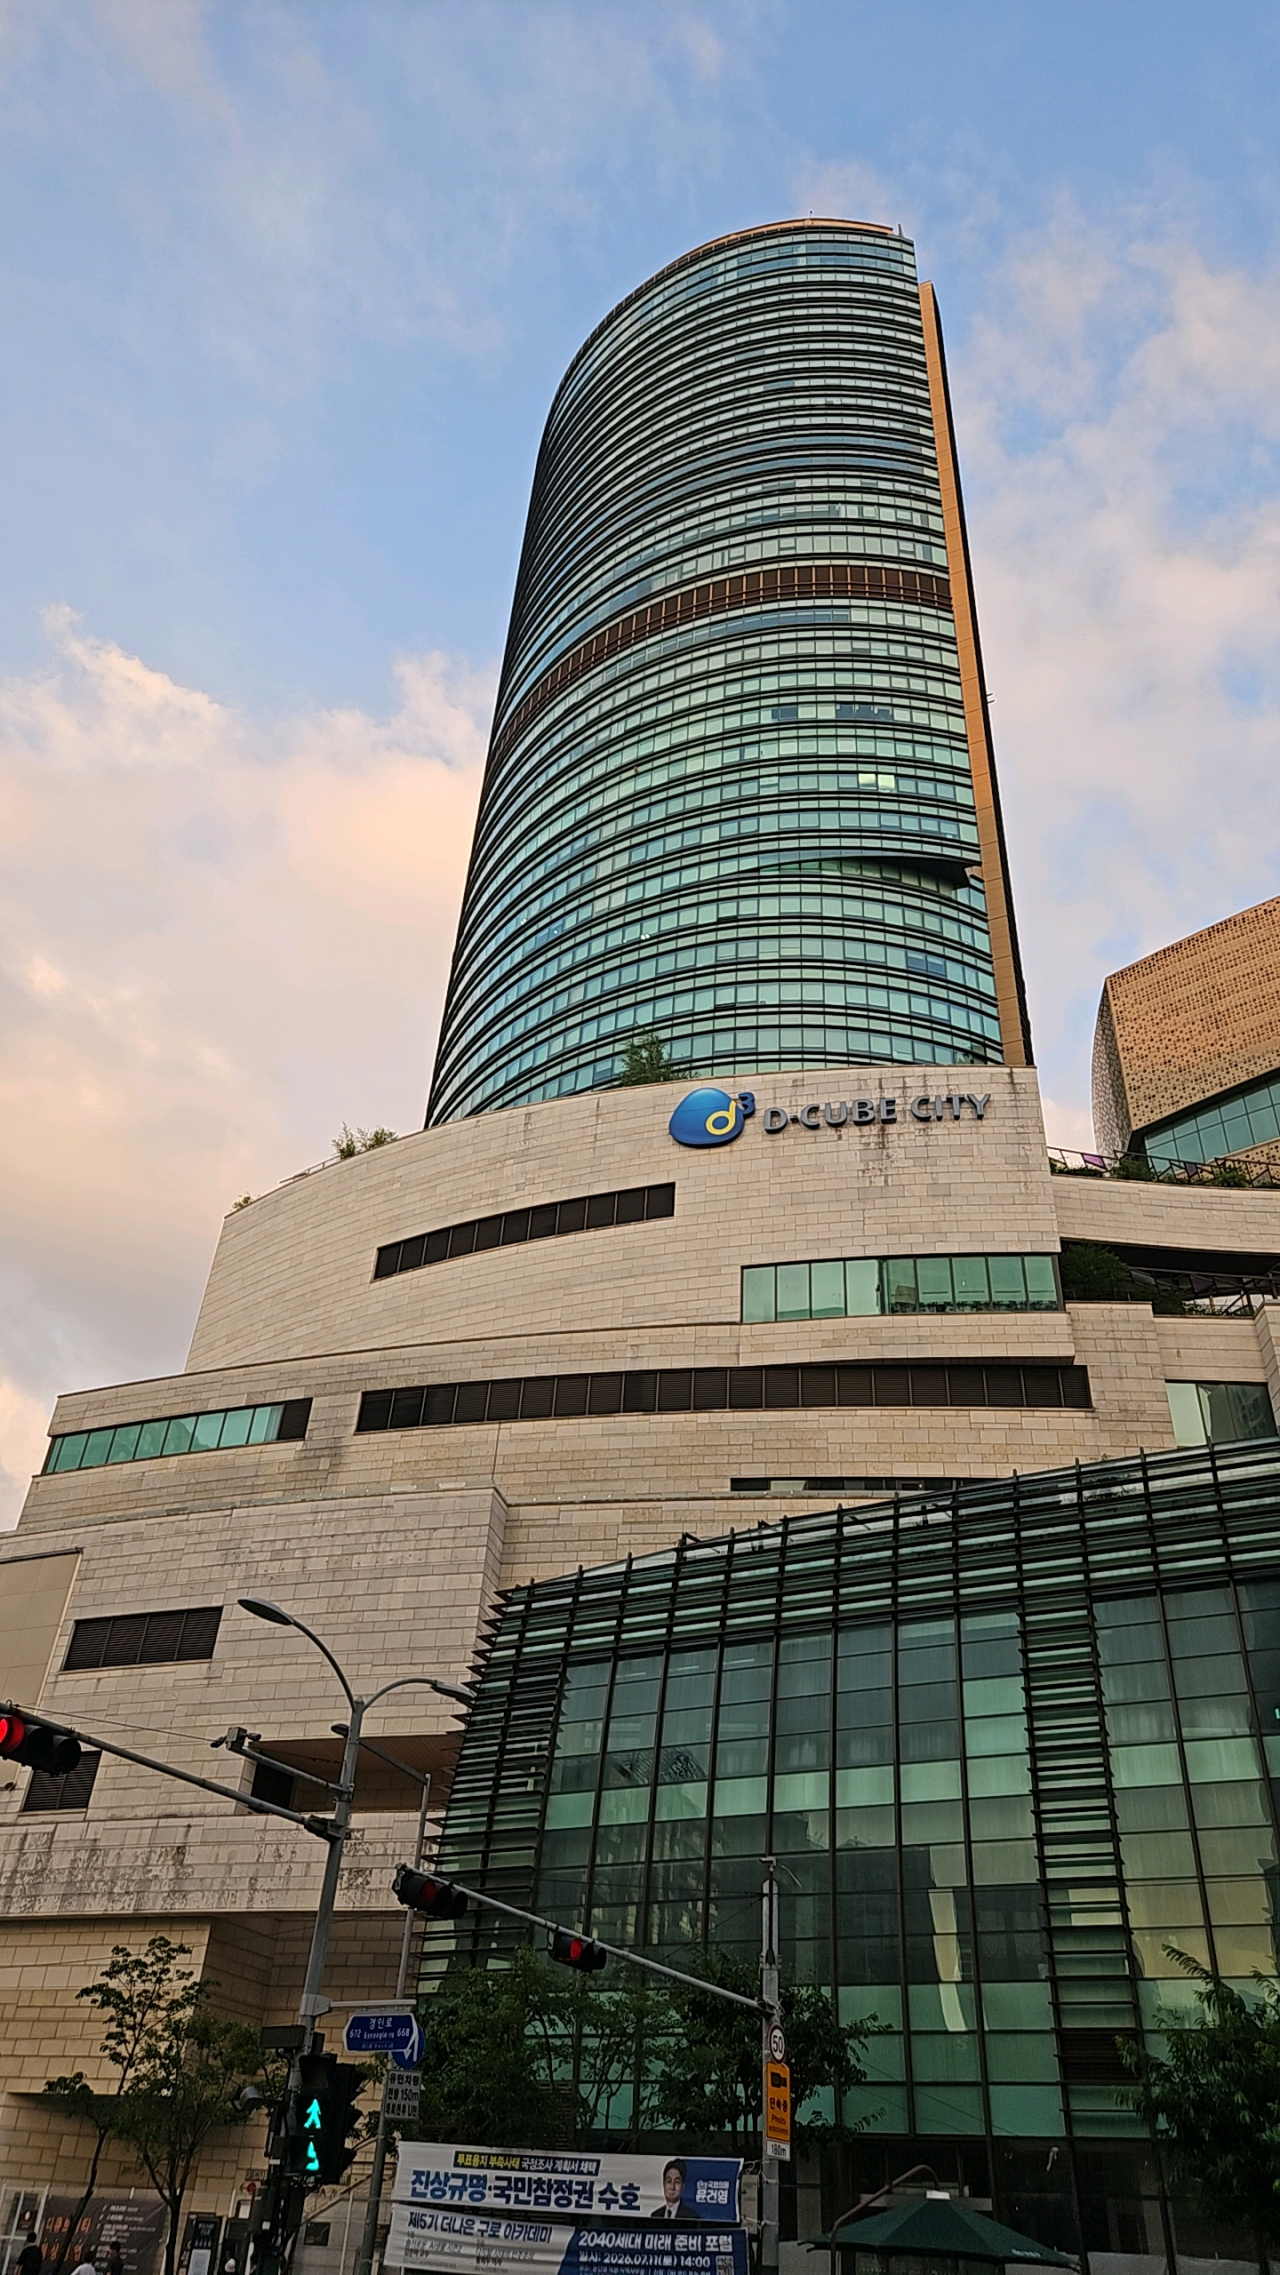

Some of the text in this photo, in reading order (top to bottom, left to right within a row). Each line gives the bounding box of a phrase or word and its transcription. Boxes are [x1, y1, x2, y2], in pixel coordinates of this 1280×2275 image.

[764, 1098, 897, 1134] D-CUBE
[910, 1094, 992, 1121] CITY
[369, 2017, 393, 2030] 경인로
[349, 2028, 362, 2039] 672
[397, 2027, 410, 2038] 668
[773, 2035, 783, 2054] 50
[389, 2073, 420, 2086] 유턴차량
[401, 2088, 419, 2101] 150m
[770, 2097, 788, 2113] 단속중
[771, 2143, 787, 2158] 180m
[457, 2153, 598, 2174] 투표용지 부족사태 국정조사 계획서 채택
[410, 2170, 641, 2211] 진상규명·국민참정권 수호
[695, 2189, 728, 2205] 윤건영
[408, 2212, 553, 2244] 제5기 더나은 구로 아카데미
[578, 2230, 733, 2253] 2040세대 미래 준비 포럼
[578, 2252, 602, 2263] 일시:
[680, 2255, 711, 2268] 14:00
